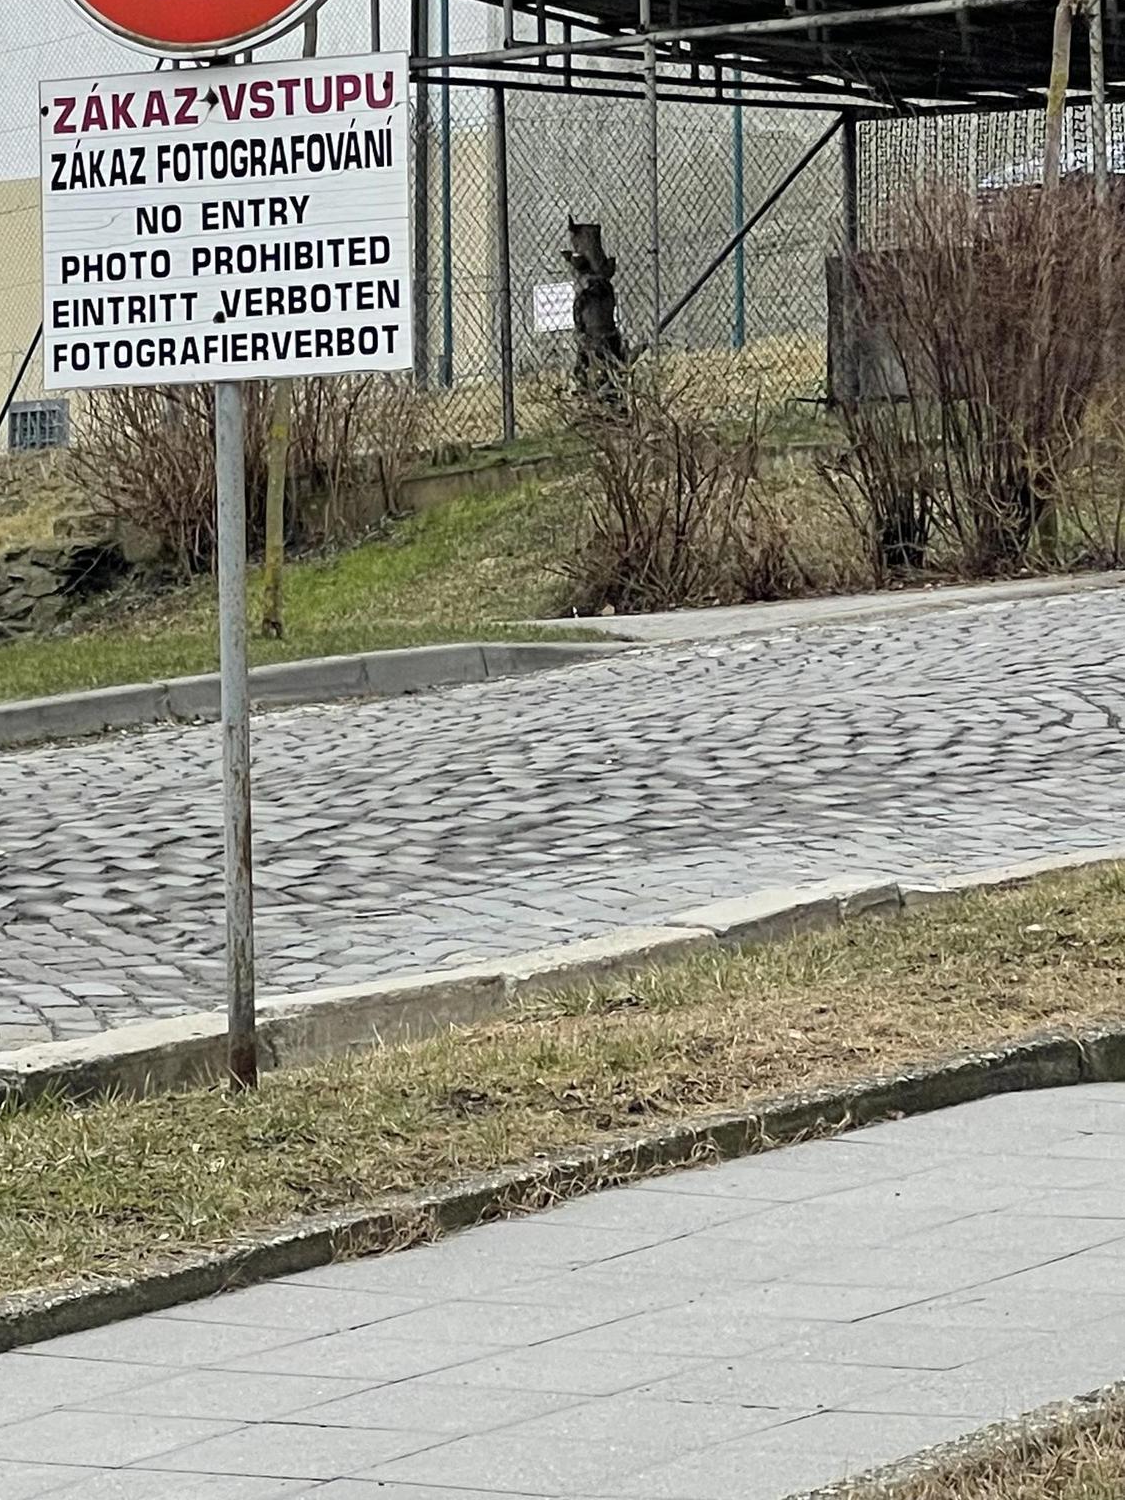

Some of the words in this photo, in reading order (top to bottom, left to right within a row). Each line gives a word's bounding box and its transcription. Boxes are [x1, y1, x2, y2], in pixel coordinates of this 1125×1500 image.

[53, 82, 199, 135] ZÁKAZ
[218, 71, 394, 121] VSTUPU
[50, 140, 146, 191] ZÁKAZ
[157, 116, 393, 183] FOTOGRAFOVÁNÍ
[136, 204, 182, 235] NO
[201, 195, 310, 231] ENTRY
[61, 249, 171, 284] PHOTO
[192, 235, 390, 277] PROHIBITED
[53, 292, 198, 329] EINTRITT
[220, 279, 400, 318] VERBOTEN
[53, 325, 399, 372] FOTOGRAFIERVERBOT
